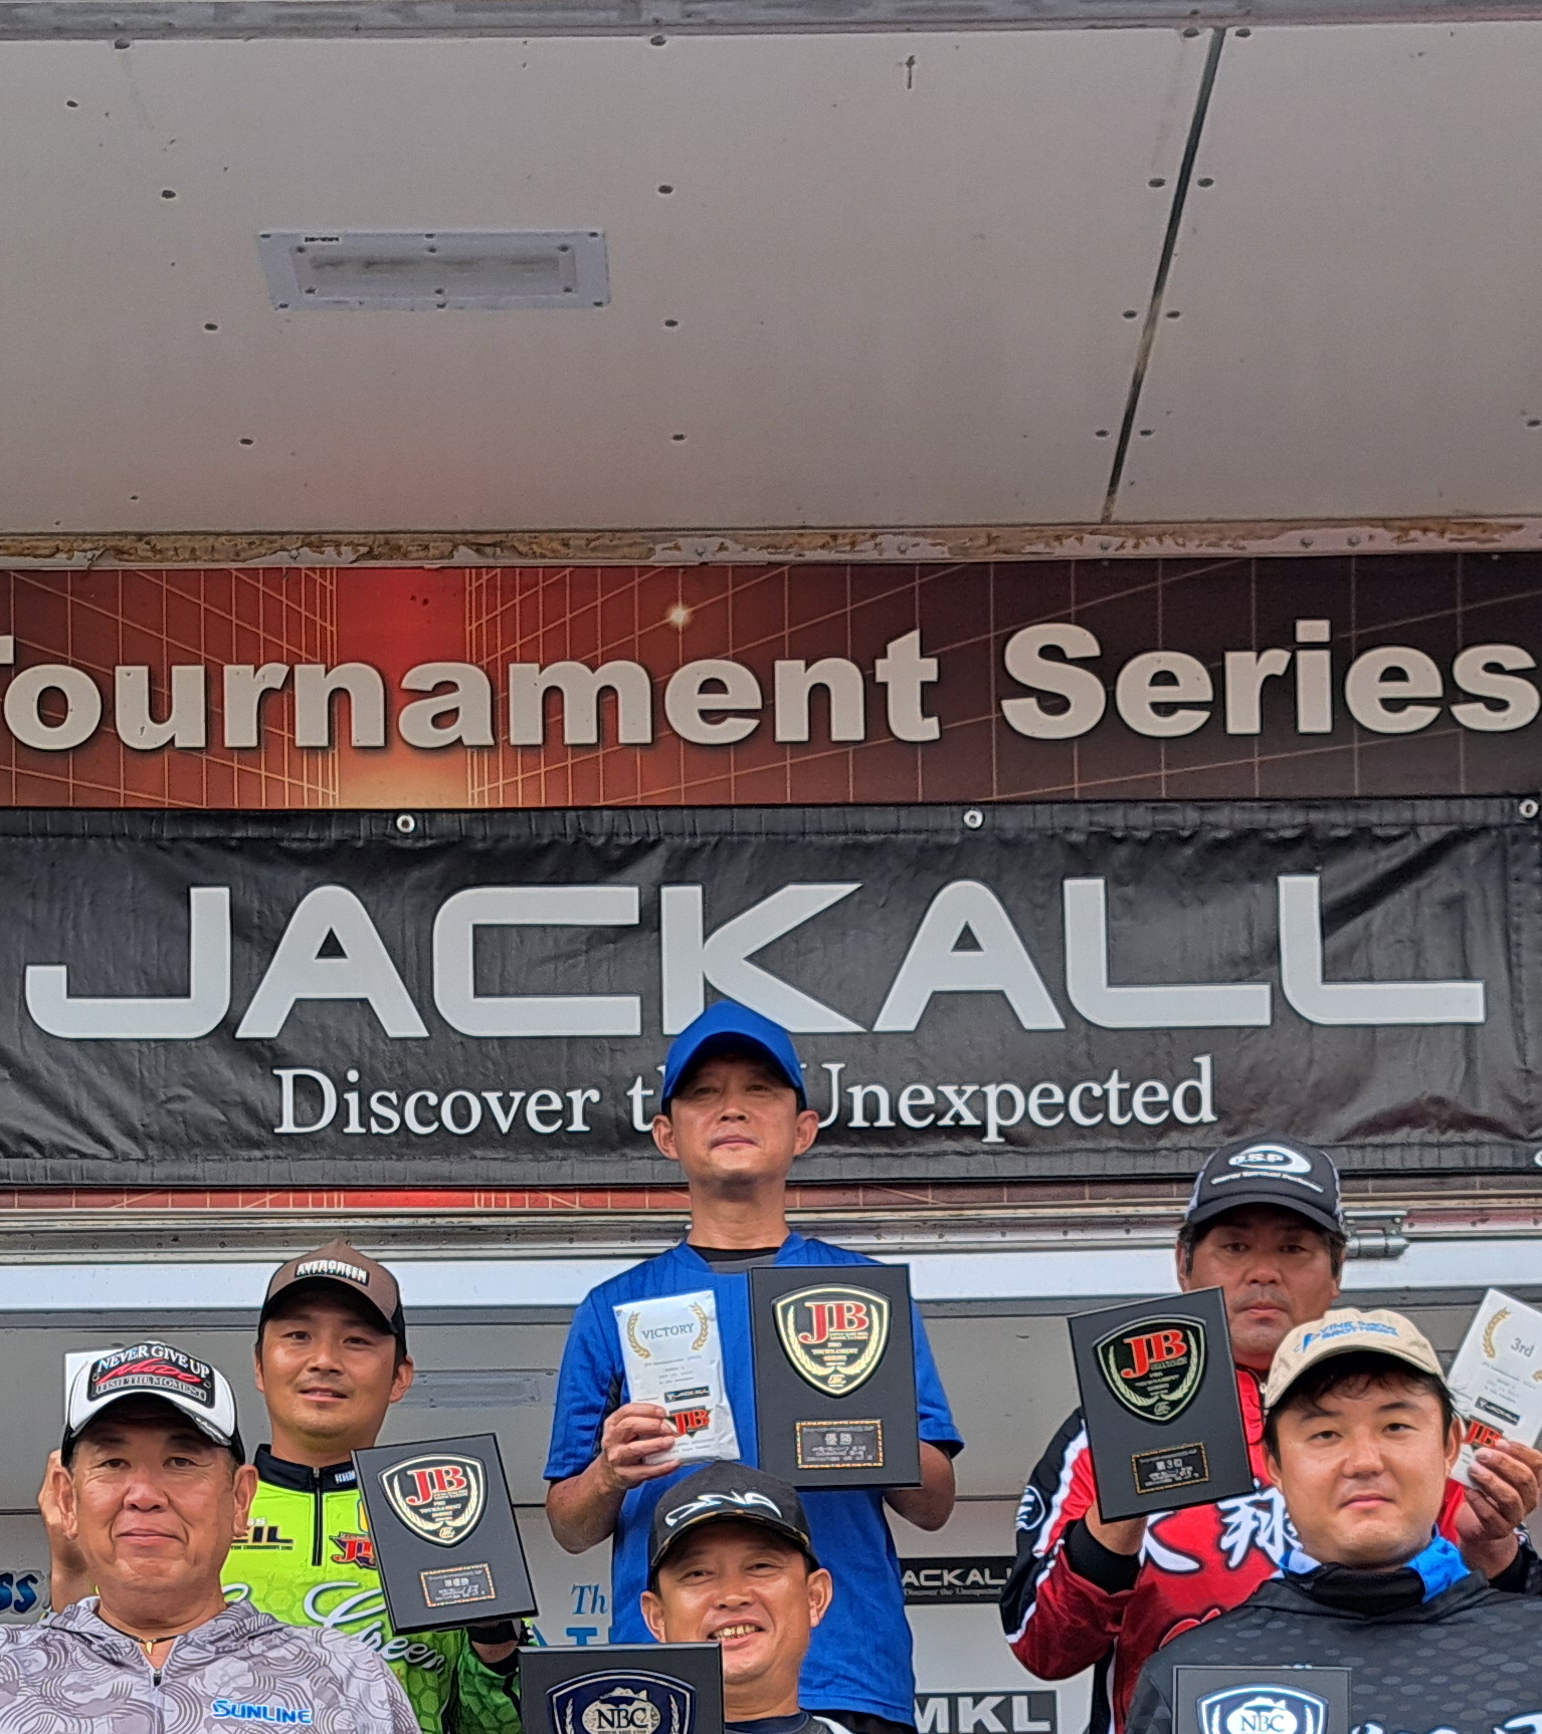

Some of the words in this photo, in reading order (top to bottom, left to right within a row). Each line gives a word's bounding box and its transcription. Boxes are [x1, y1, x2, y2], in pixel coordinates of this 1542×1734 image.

[1000, 620, 1542, 741] Series
[24, 874, 1487, 1040] JACKALL
[274, 1068, 599, 1136] Discover
[806, 1054, 1218, 1143] Unexpected
[641, 1322, 695, 1341] VICTORY
[798, 1300, 870, 1344] JB
[97, 1345, 149, 1373] NEVER
[150, 1345, 190, 1366] GIVE
[189, 1358, 210, 1379] UP
[1121, 1328, 1188, 1379] JB
[1510, 1337, 1536, 1359] 3rd
[405, 1465, 468, 1507] JB
[901, 1568, 1012, 1587] ACKAL
[211, 1699, 313, 1726] SUNLINE
[596, 1707, 649, 1730] NBC
[1240, 1714, 1286, 1733] NBC
